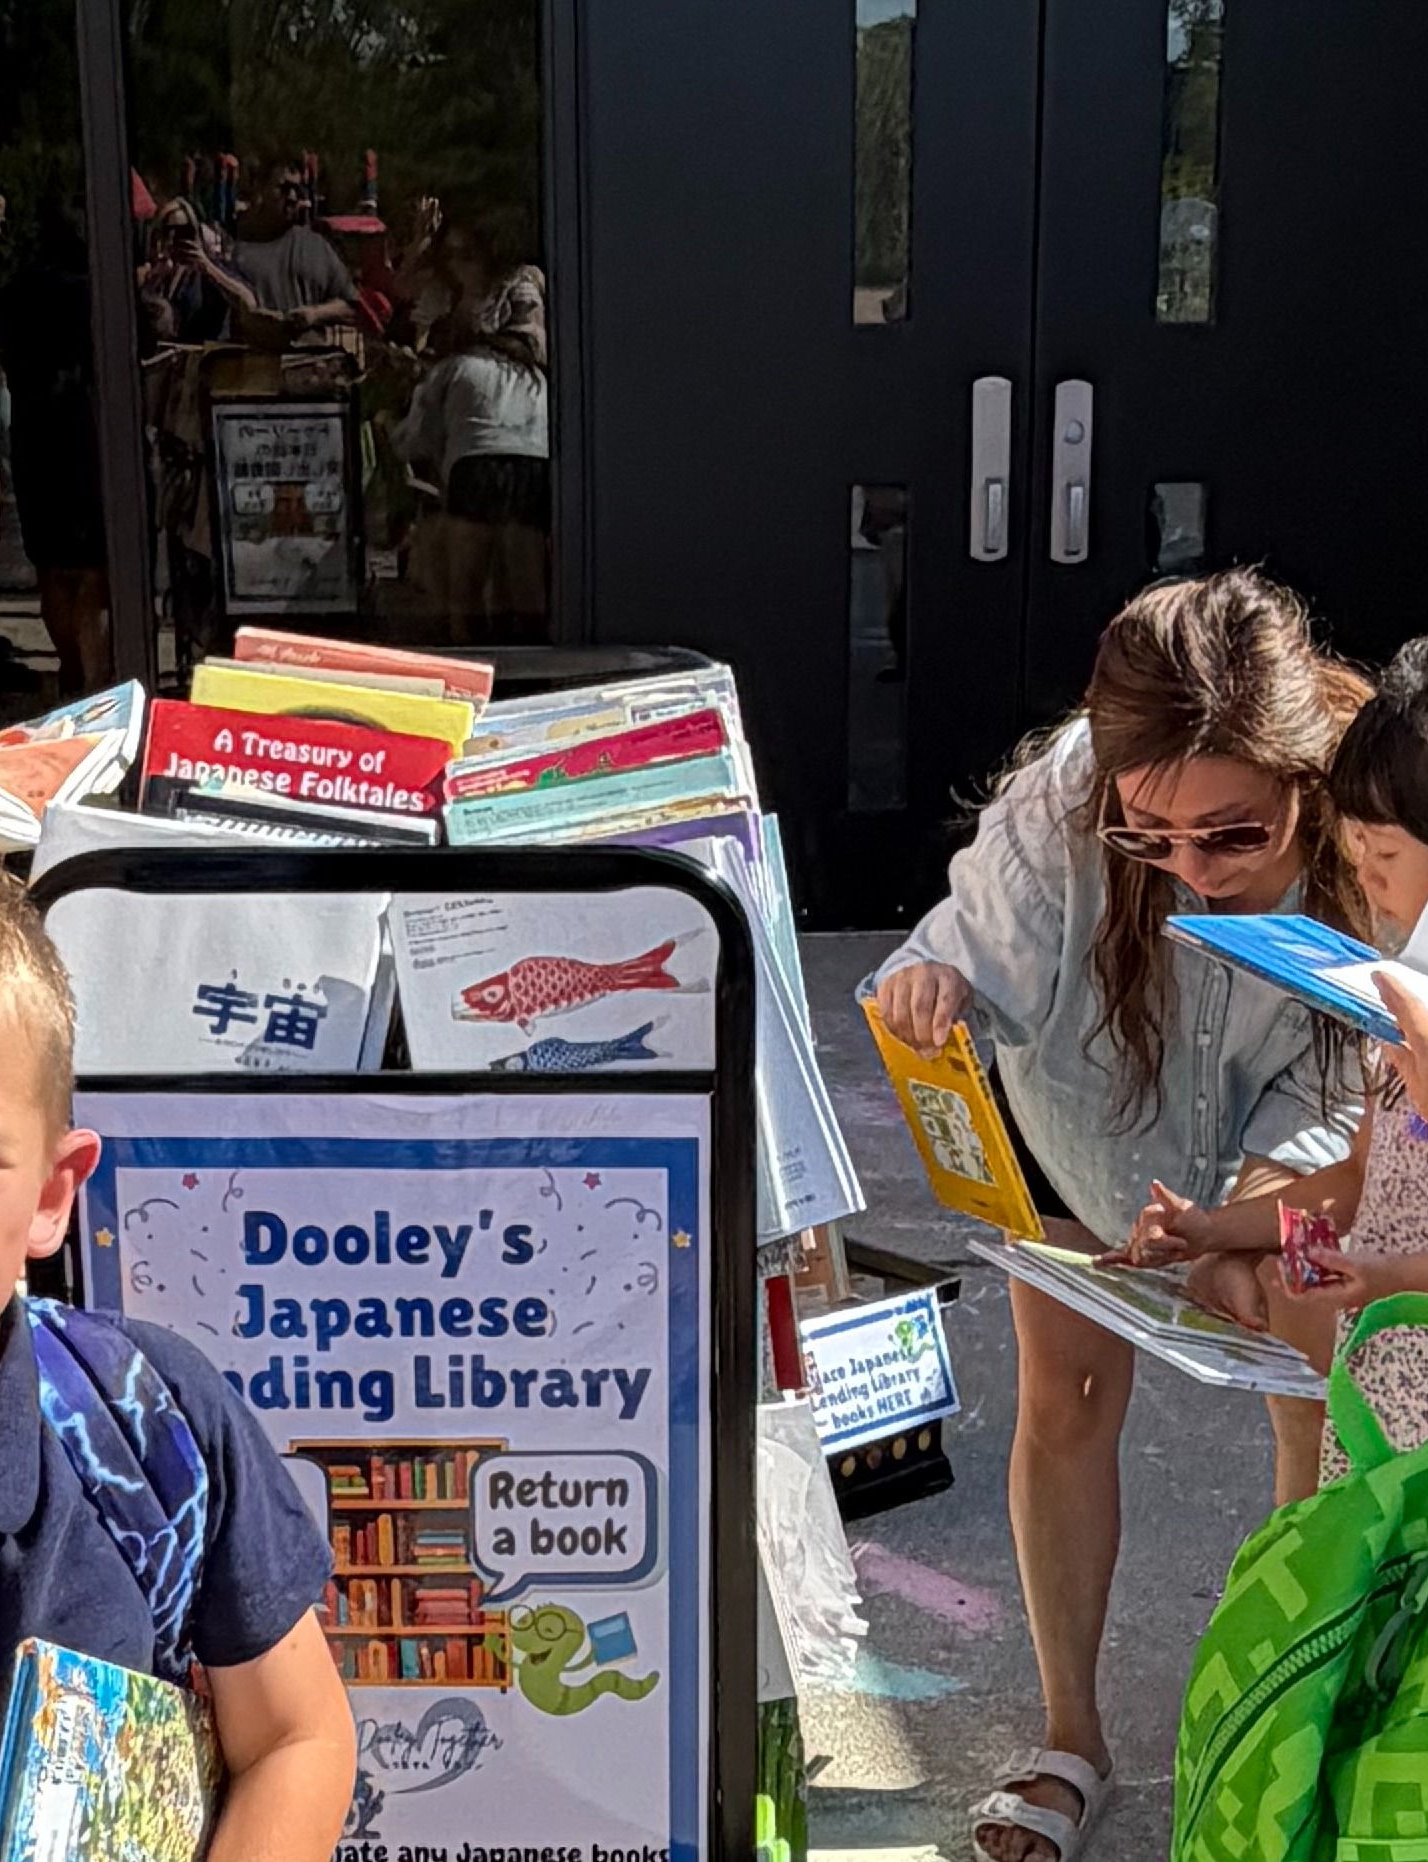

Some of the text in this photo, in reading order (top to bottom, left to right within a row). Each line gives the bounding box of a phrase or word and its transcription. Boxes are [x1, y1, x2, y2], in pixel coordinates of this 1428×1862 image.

[213, 729, 385, 774] A Treasury of
[299, 771, 426, 812] Folktales
[193, 983, 328, 1050] 宇宙
[243, 1209, 534, 1278] Dooley's
[236, 1284, 549, 1351] Japanese
[414, 1354, 651, 1419] Library
[871, 1367, 920, 1393] Library
[831, 1388, 913, 1429] books HERE
[489, 1470, 629, 1510] Return
[492, 1517, 627, 1556] a book
[397, 1846, 448, 1862] any
[456, 1842, 582, 1862] Japanese
[592, 1843, 671, 1862] books
